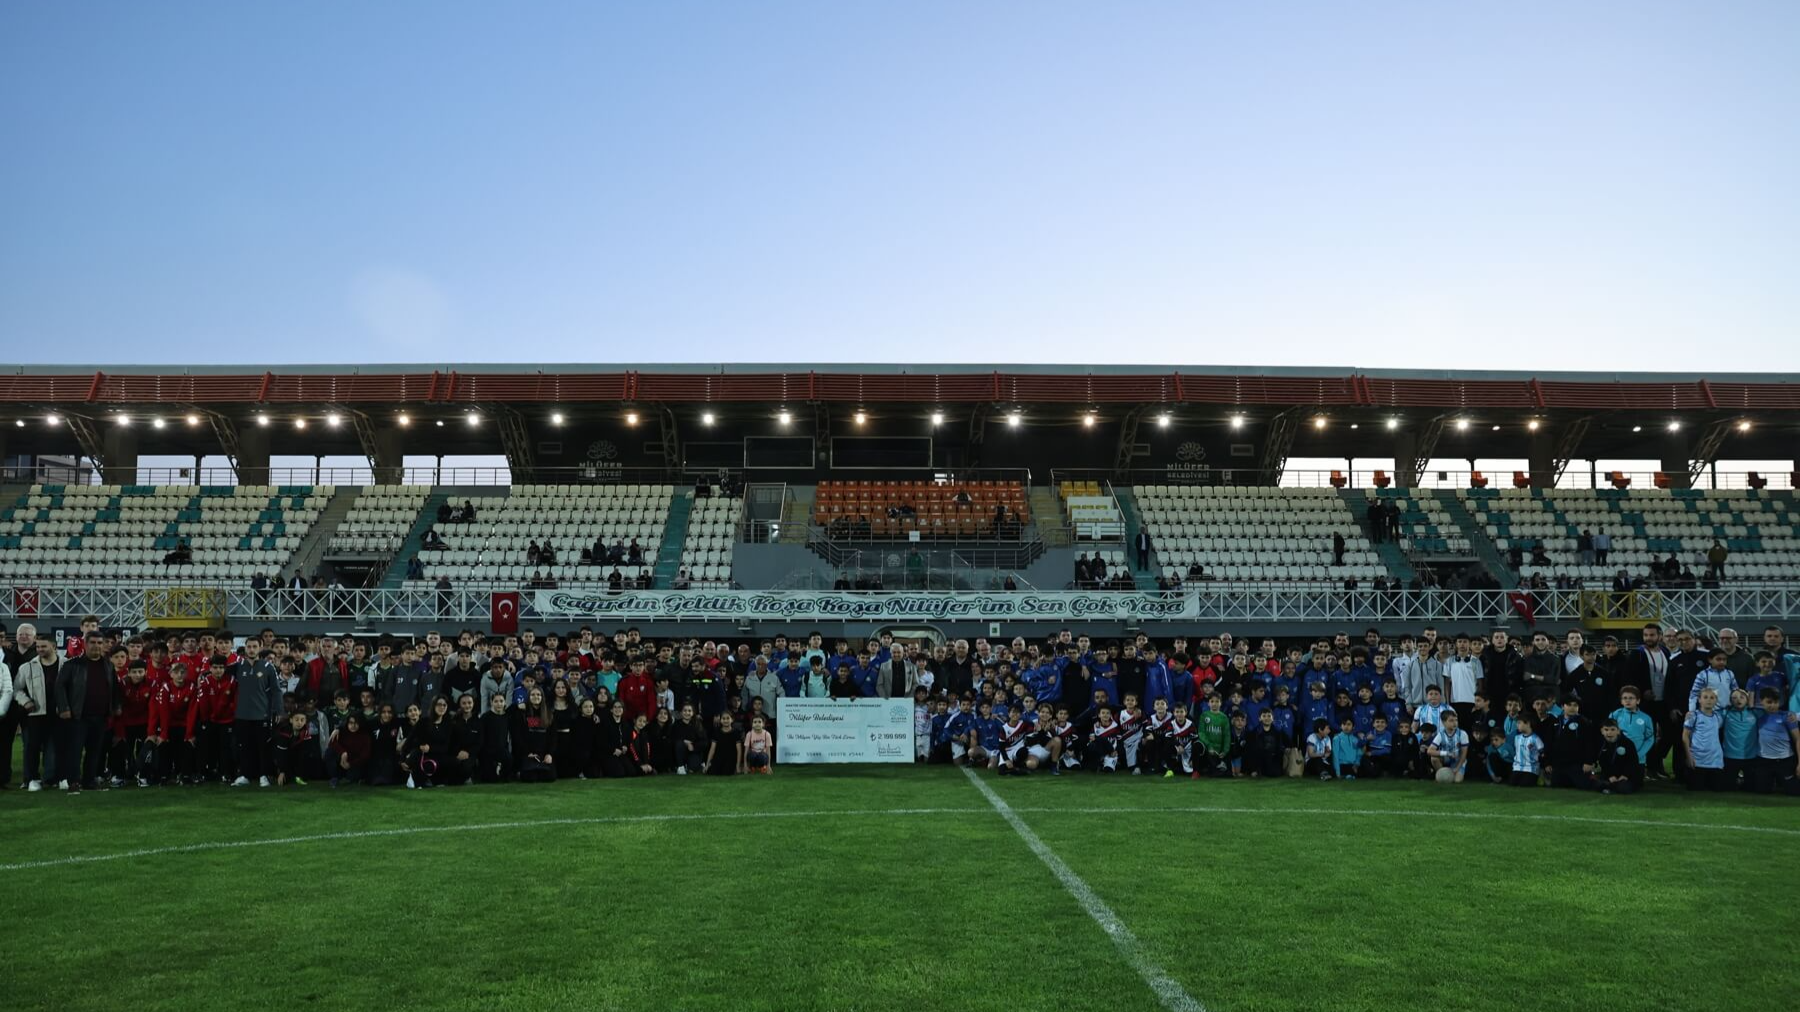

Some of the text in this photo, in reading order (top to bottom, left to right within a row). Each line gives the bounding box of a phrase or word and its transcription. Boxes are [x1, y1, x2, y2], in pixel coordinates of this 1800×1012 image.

[1167, 462, 1210, 470] NİLÜFER
[550, 593, 1184, 618] Çağırdın Geldik Koşa Koşa Nilüfer'im Sen Çok Yaşa
[789, 713, 844, 722] Nilüfer Belediyesi
